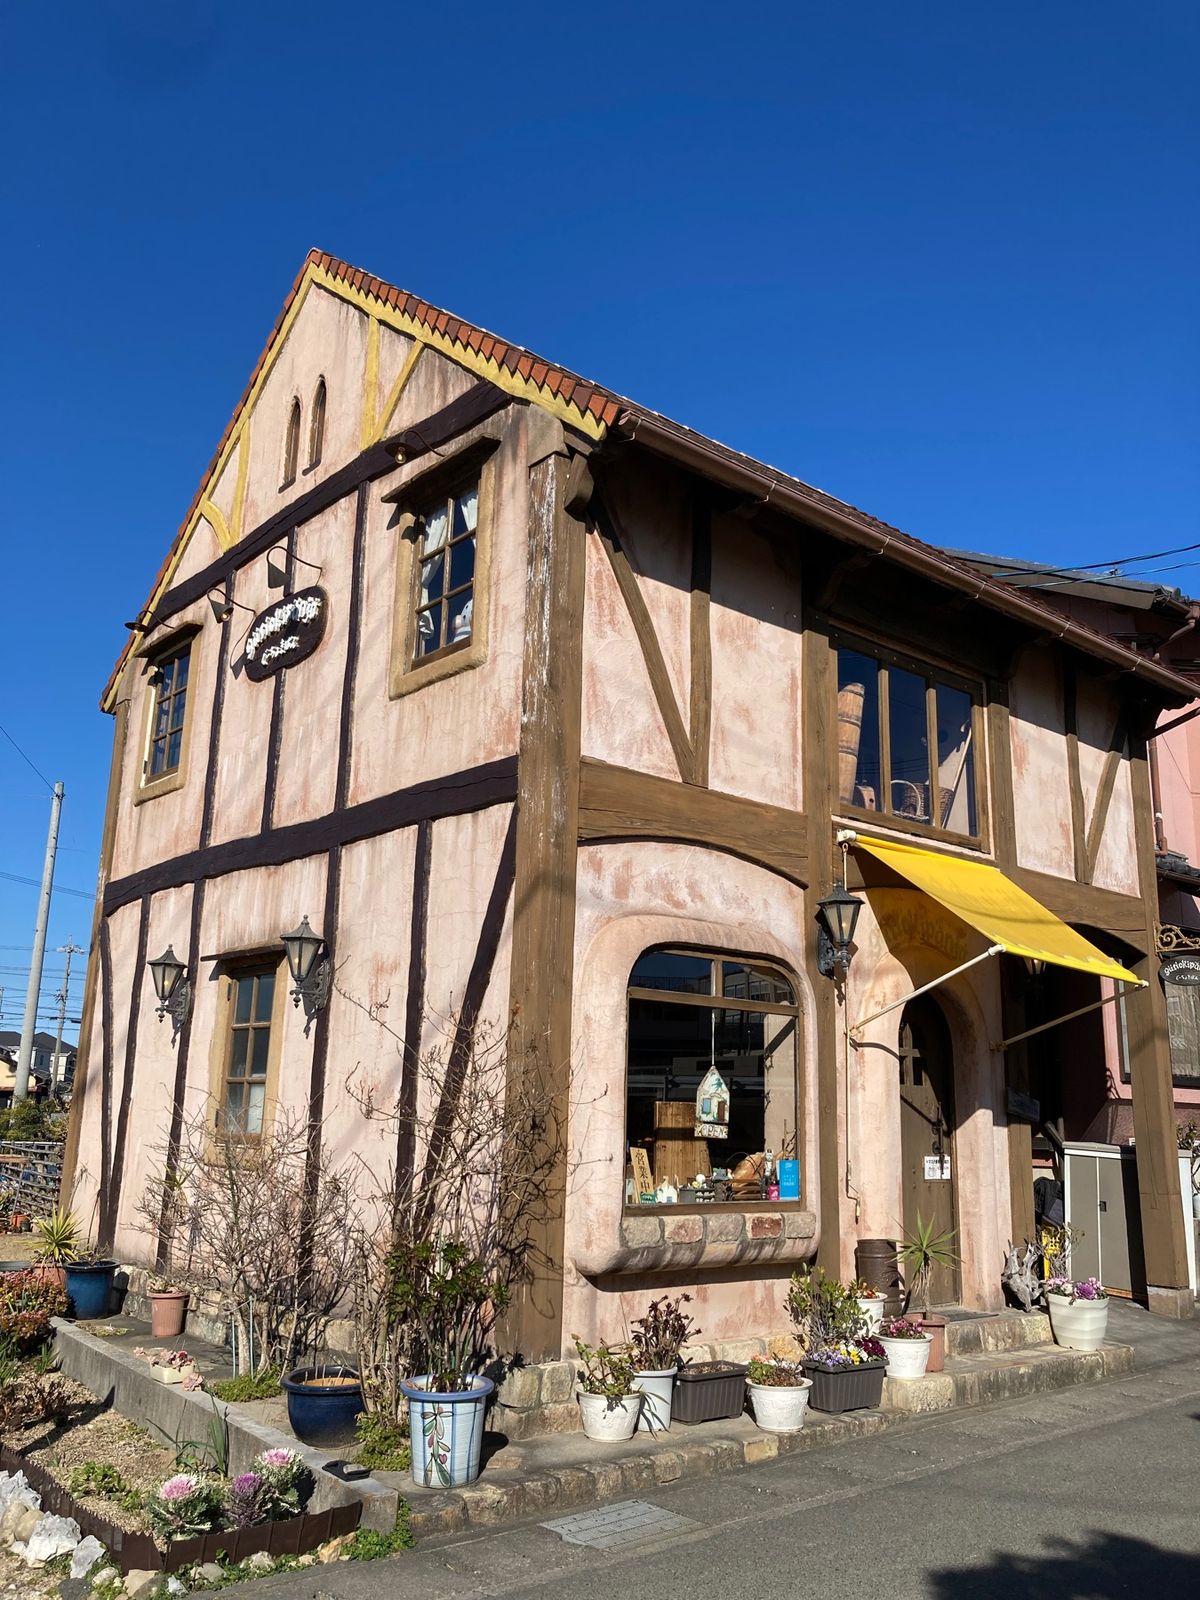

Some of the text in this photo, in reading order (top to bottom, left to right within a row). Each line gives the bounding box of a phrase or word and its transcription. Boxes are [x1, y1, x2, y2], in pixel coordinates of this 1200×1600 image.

[700, 1124, 724, 1138] OPEN
[635, 1149, 650, 1193] 営業中
